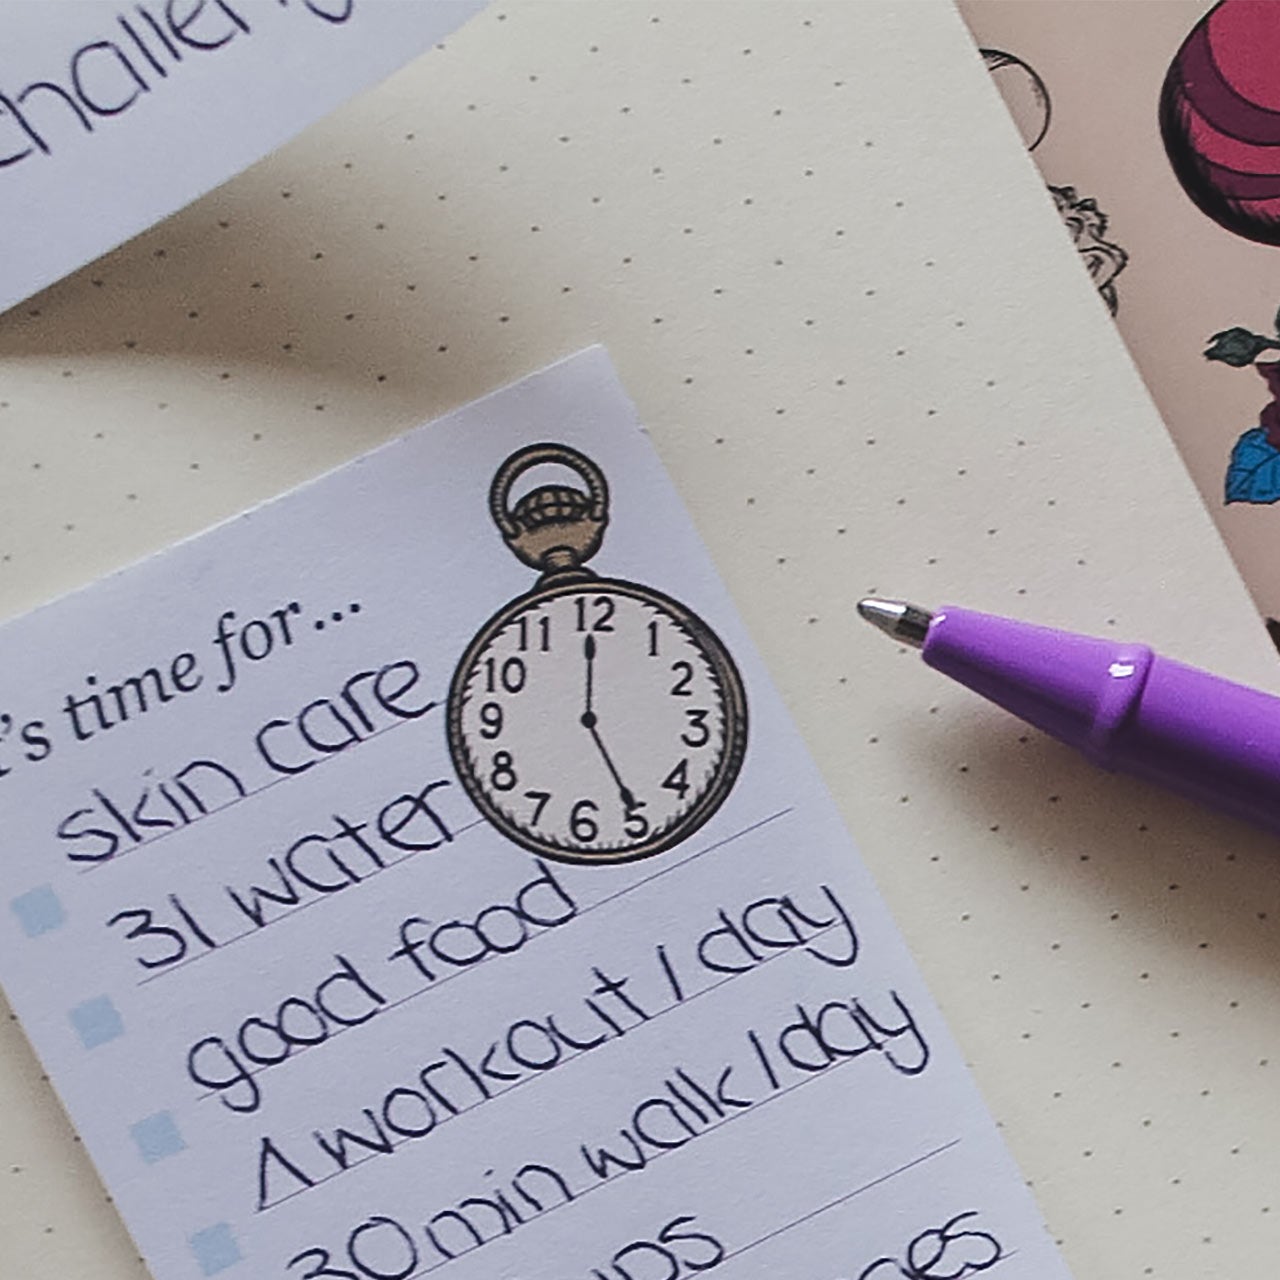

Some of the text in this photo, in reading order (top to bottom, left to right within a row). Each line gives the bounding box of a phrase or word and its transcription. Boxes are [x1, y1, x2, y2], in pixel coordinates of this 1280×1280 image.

[0, 0, 353, 168] halle
[516, 615, 550, 652] 11
[574, 595, 615, 632] 12
[647, 620, 660, 657] 1
[484, 656, 526, 693] 10
[670, 660, 693, 696] 2
[0, 712, 51, 778] 's
[63, 652, 203, 741] time
[479, 701, 503, 740] 9
[680, 709, 710, 748] 3
[57, 660, 437, 863] skin care
[490, 750, 517, 792] 8
[660, 758, 690, 800] 4
[523, 790, 551, 826] 7
[569, 799, 599, 842] 6
[623, 800, 649, 839] 5
[225, 780, 452, 928] water
[188, 858, 579, 1113] good food
[313, 967, 651, 1170] workout
[697, 884, 858, 974] day
